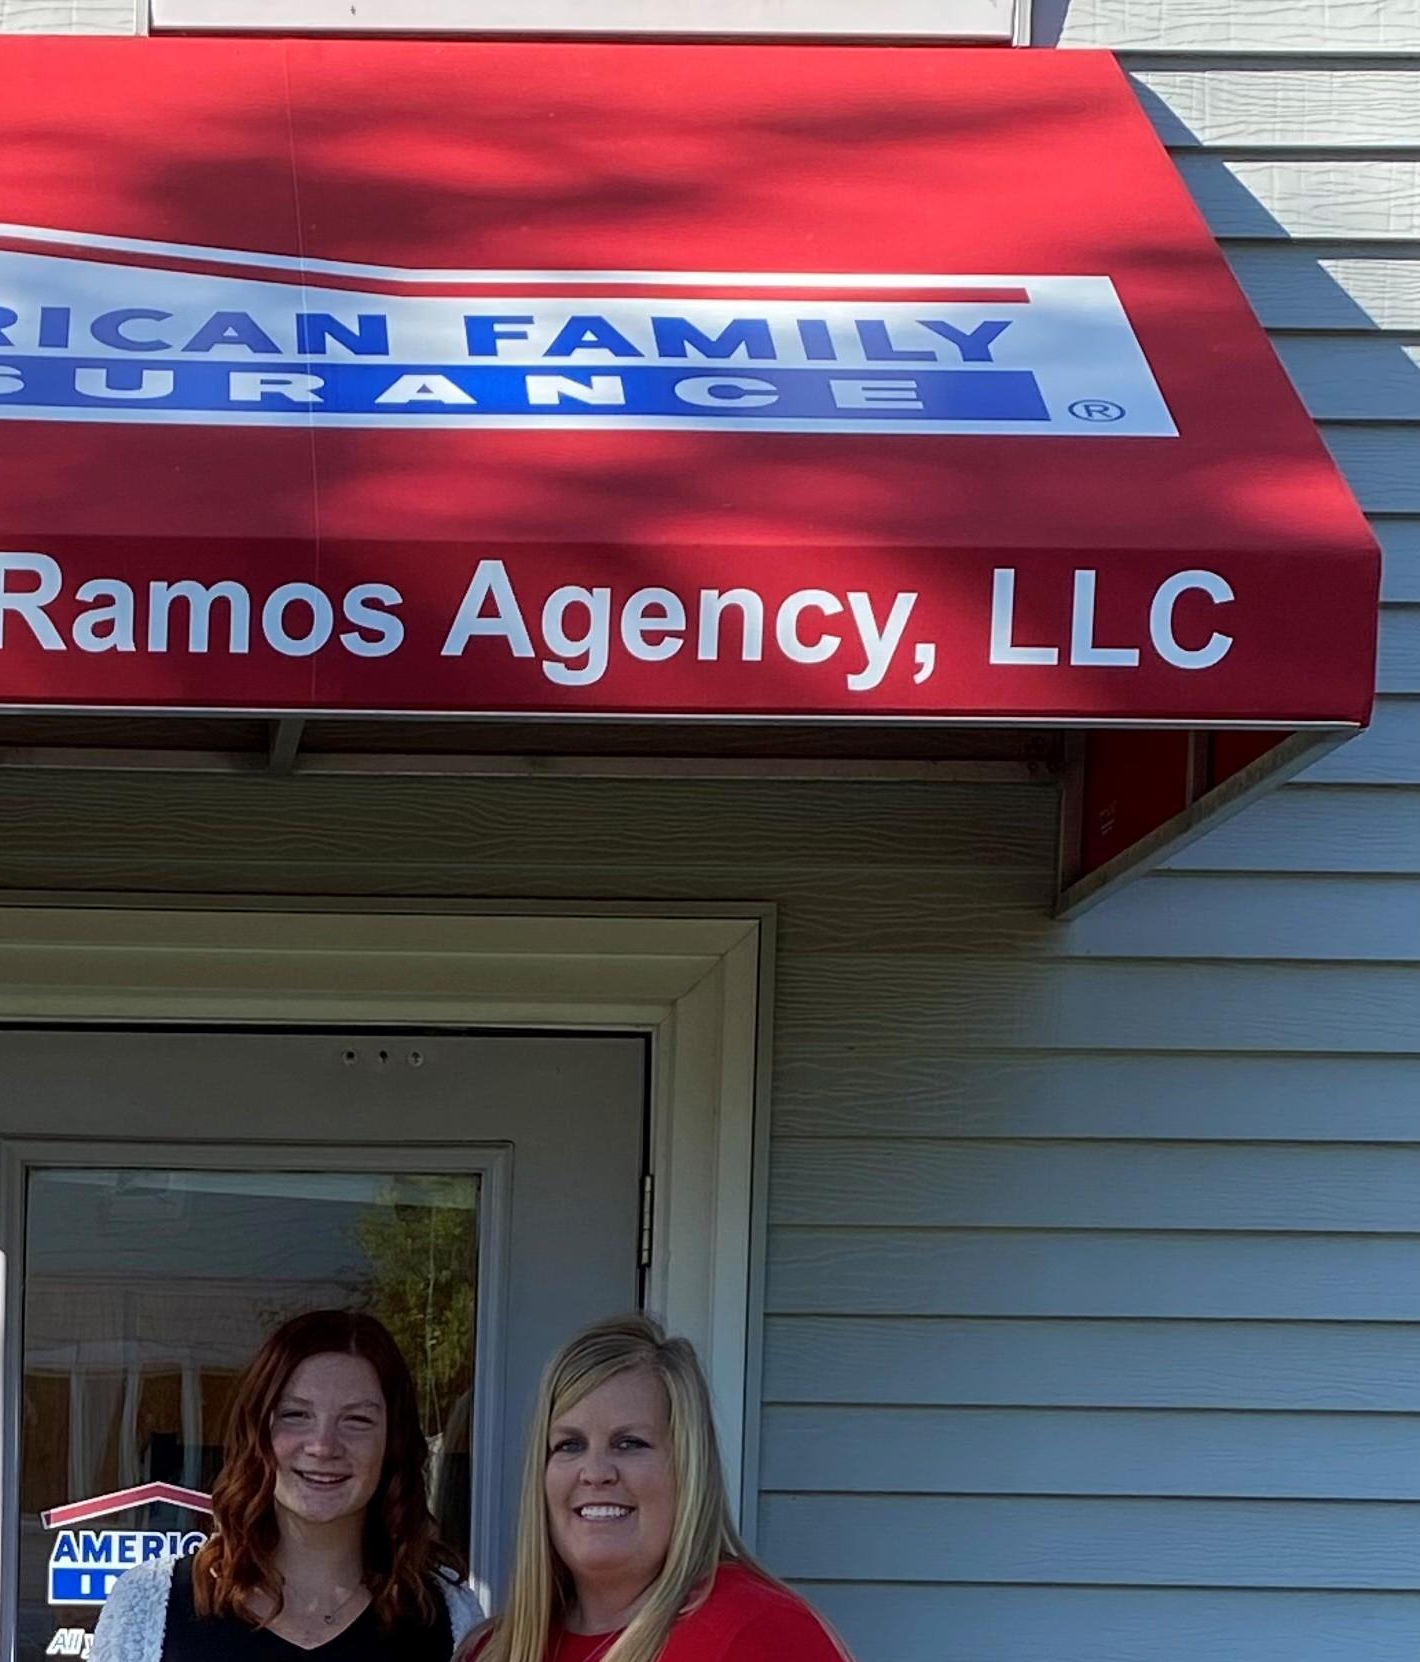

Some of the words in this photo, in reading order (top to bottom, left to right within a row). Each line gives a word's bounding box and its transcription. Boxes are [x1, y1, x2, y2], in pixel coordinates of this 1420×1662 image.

[464, 315, 1014, 363] FAMILY
[440, 558, 938, 693] Agency,
[988, 567, 1236, 671] LLC
